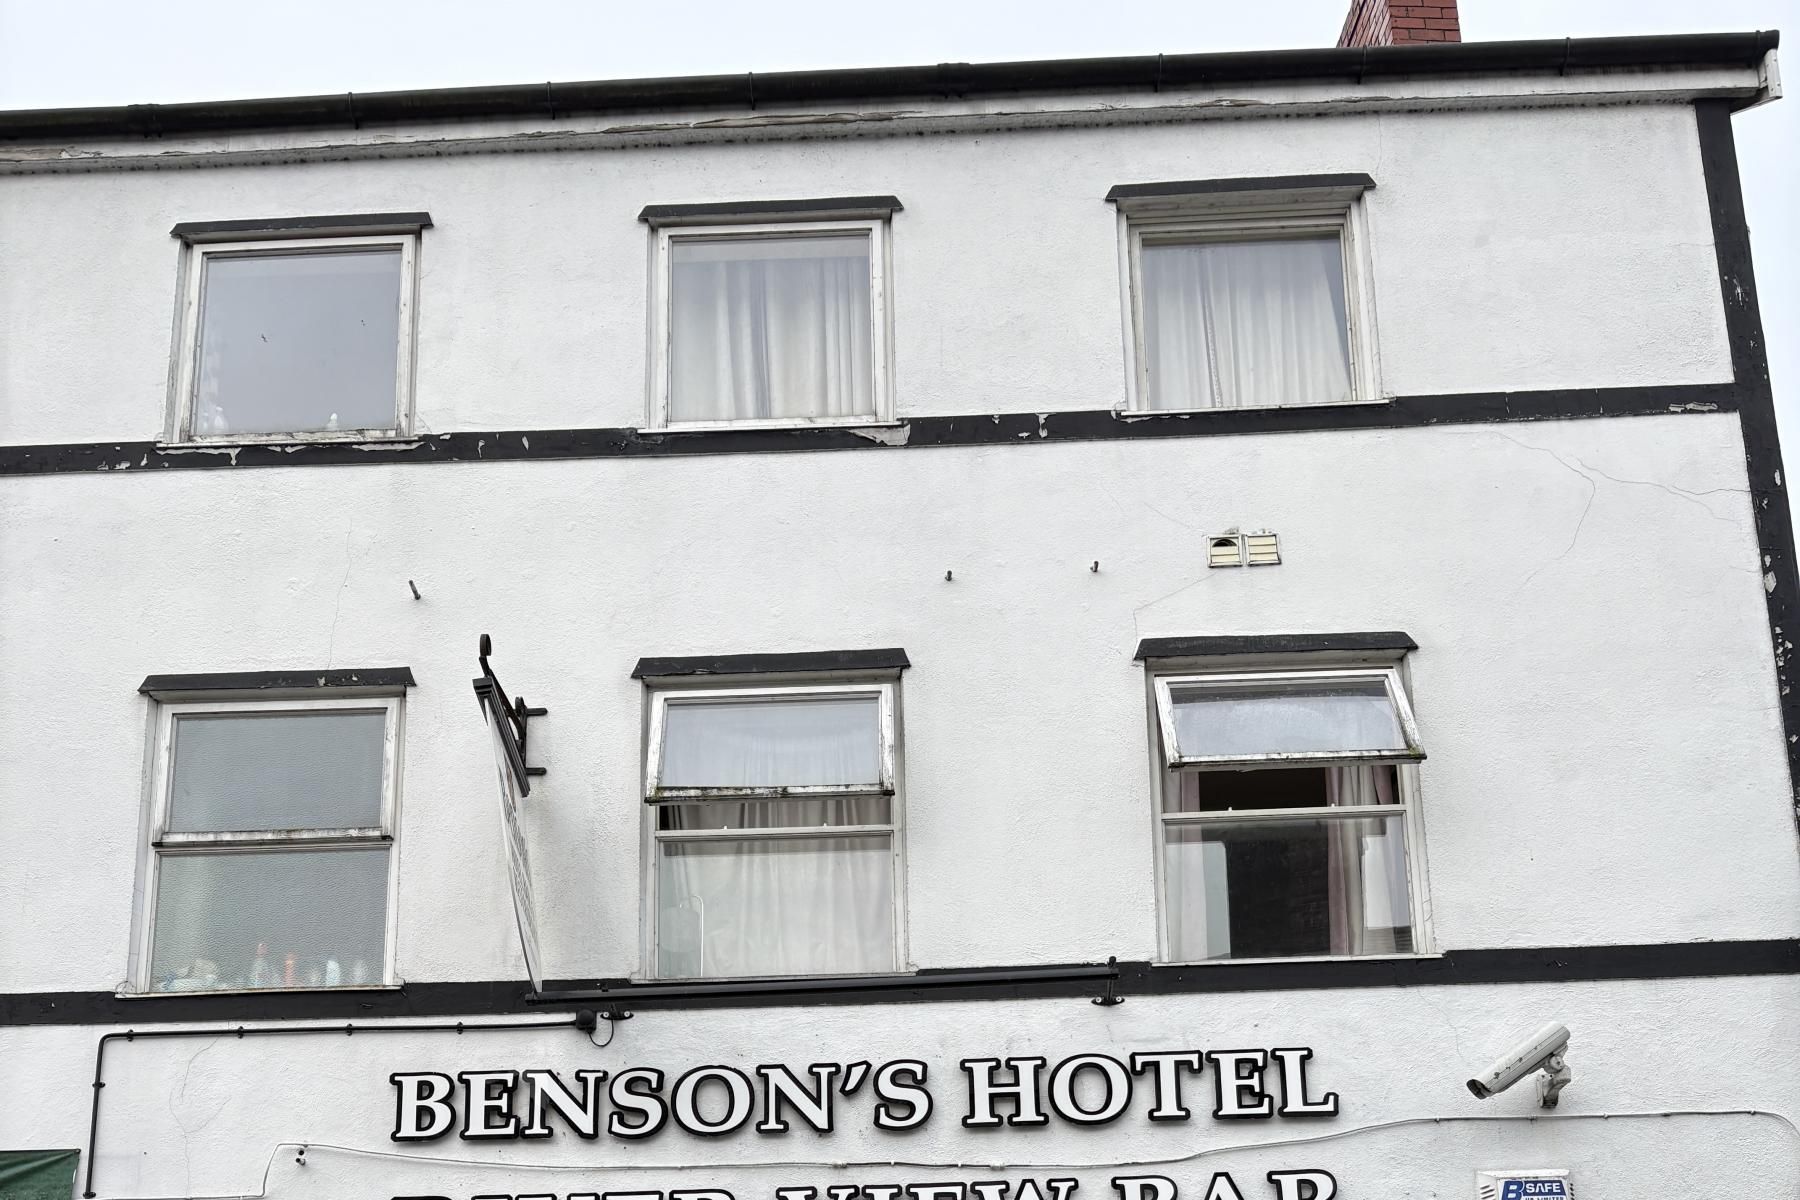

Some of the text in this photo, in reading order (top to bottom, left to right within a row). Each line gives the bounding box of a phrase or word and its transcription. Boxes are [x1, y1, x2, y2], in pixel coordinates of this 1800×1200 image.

[389, 1047, 1340, 1142] BENSON'S HOTEL
[1525, 1183, 1561, 1193] SAFE
